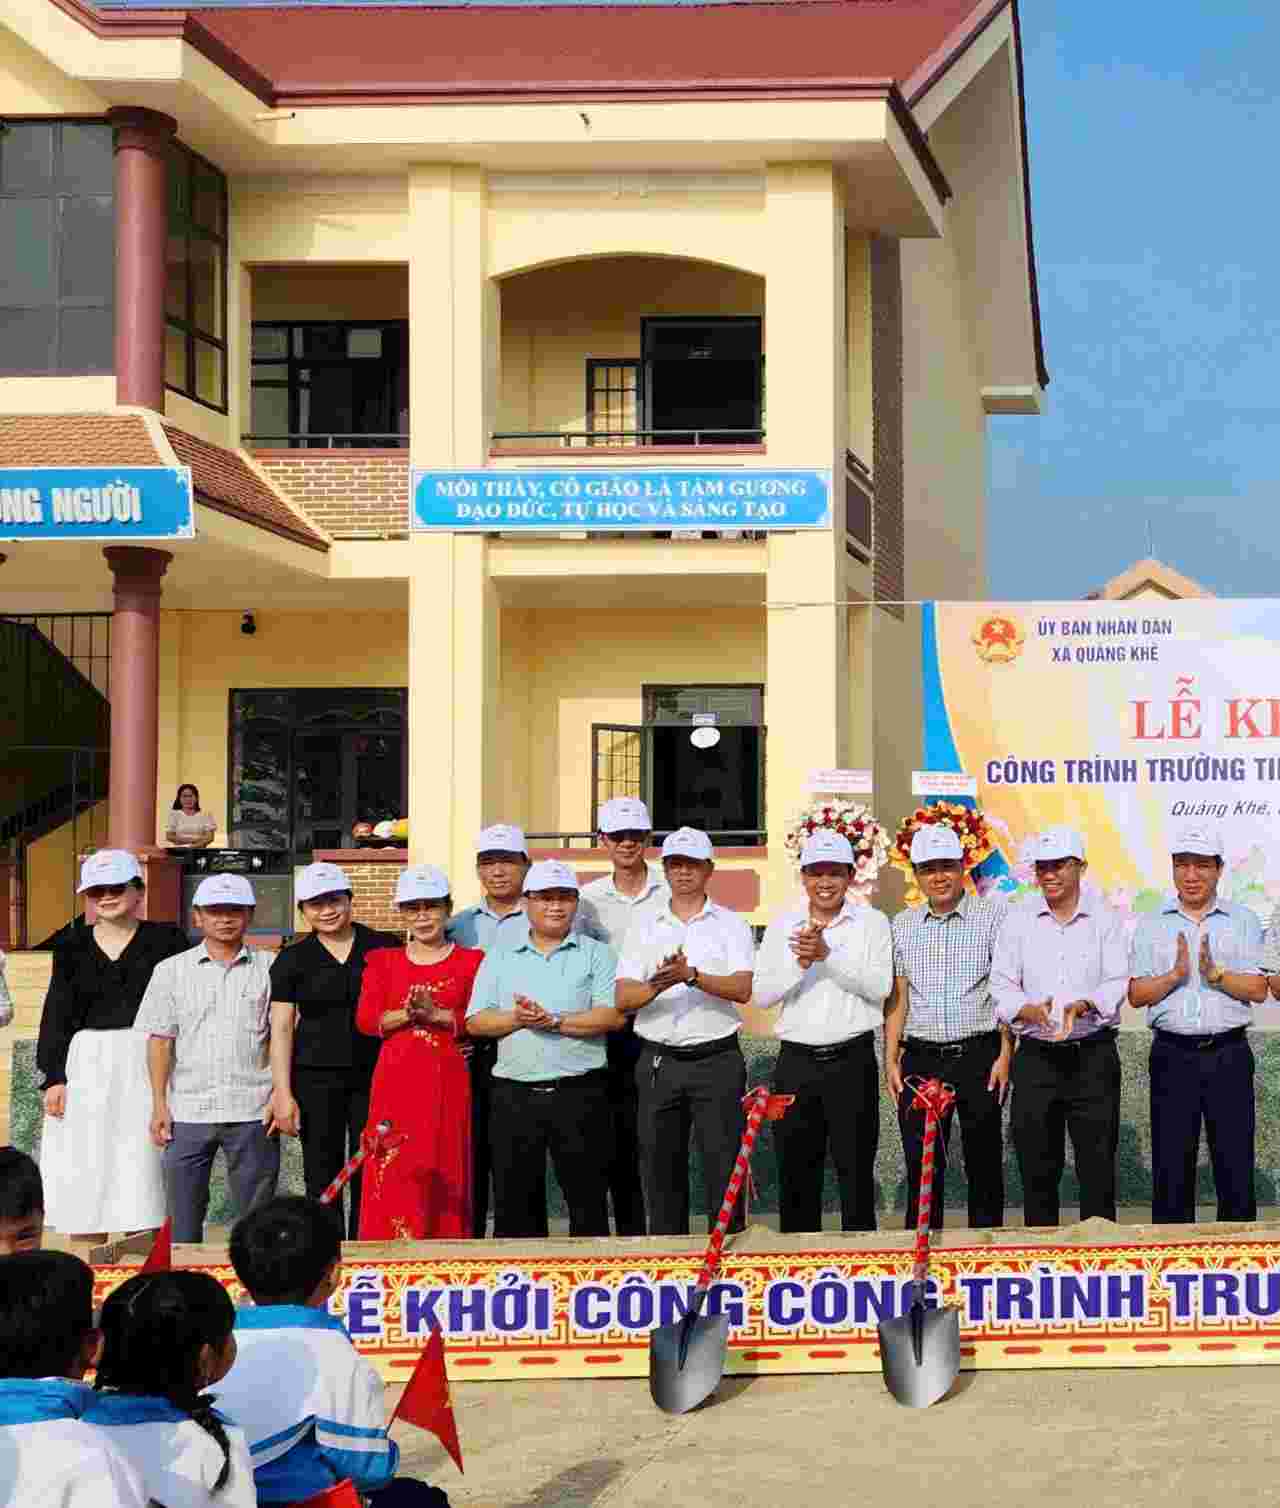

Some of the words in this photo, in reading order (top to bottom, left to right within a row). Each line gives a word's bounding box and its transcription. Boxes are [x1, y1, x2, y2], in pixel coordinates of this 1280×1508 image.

[0, 487, 43, 522] NG
[51, 477, 143, 523] NGƯỜI
[1061, 619, 1091, 636] BAN
[1129, 673, 1201, 741] LỄ
[986, 755, 1056, 784] CÔNG
[1063, 754, 1138, 783] TRÌNH
[1147, 753, 1246, 783] TRƯỜNG
[323, 1276, 380, 1333] Ễ
[406, 1272, 550, 1332] KHỞI
[574, 1276, 743, 1330] CÔNG
[961, 1266, 1144, 1321] TRÌNH
